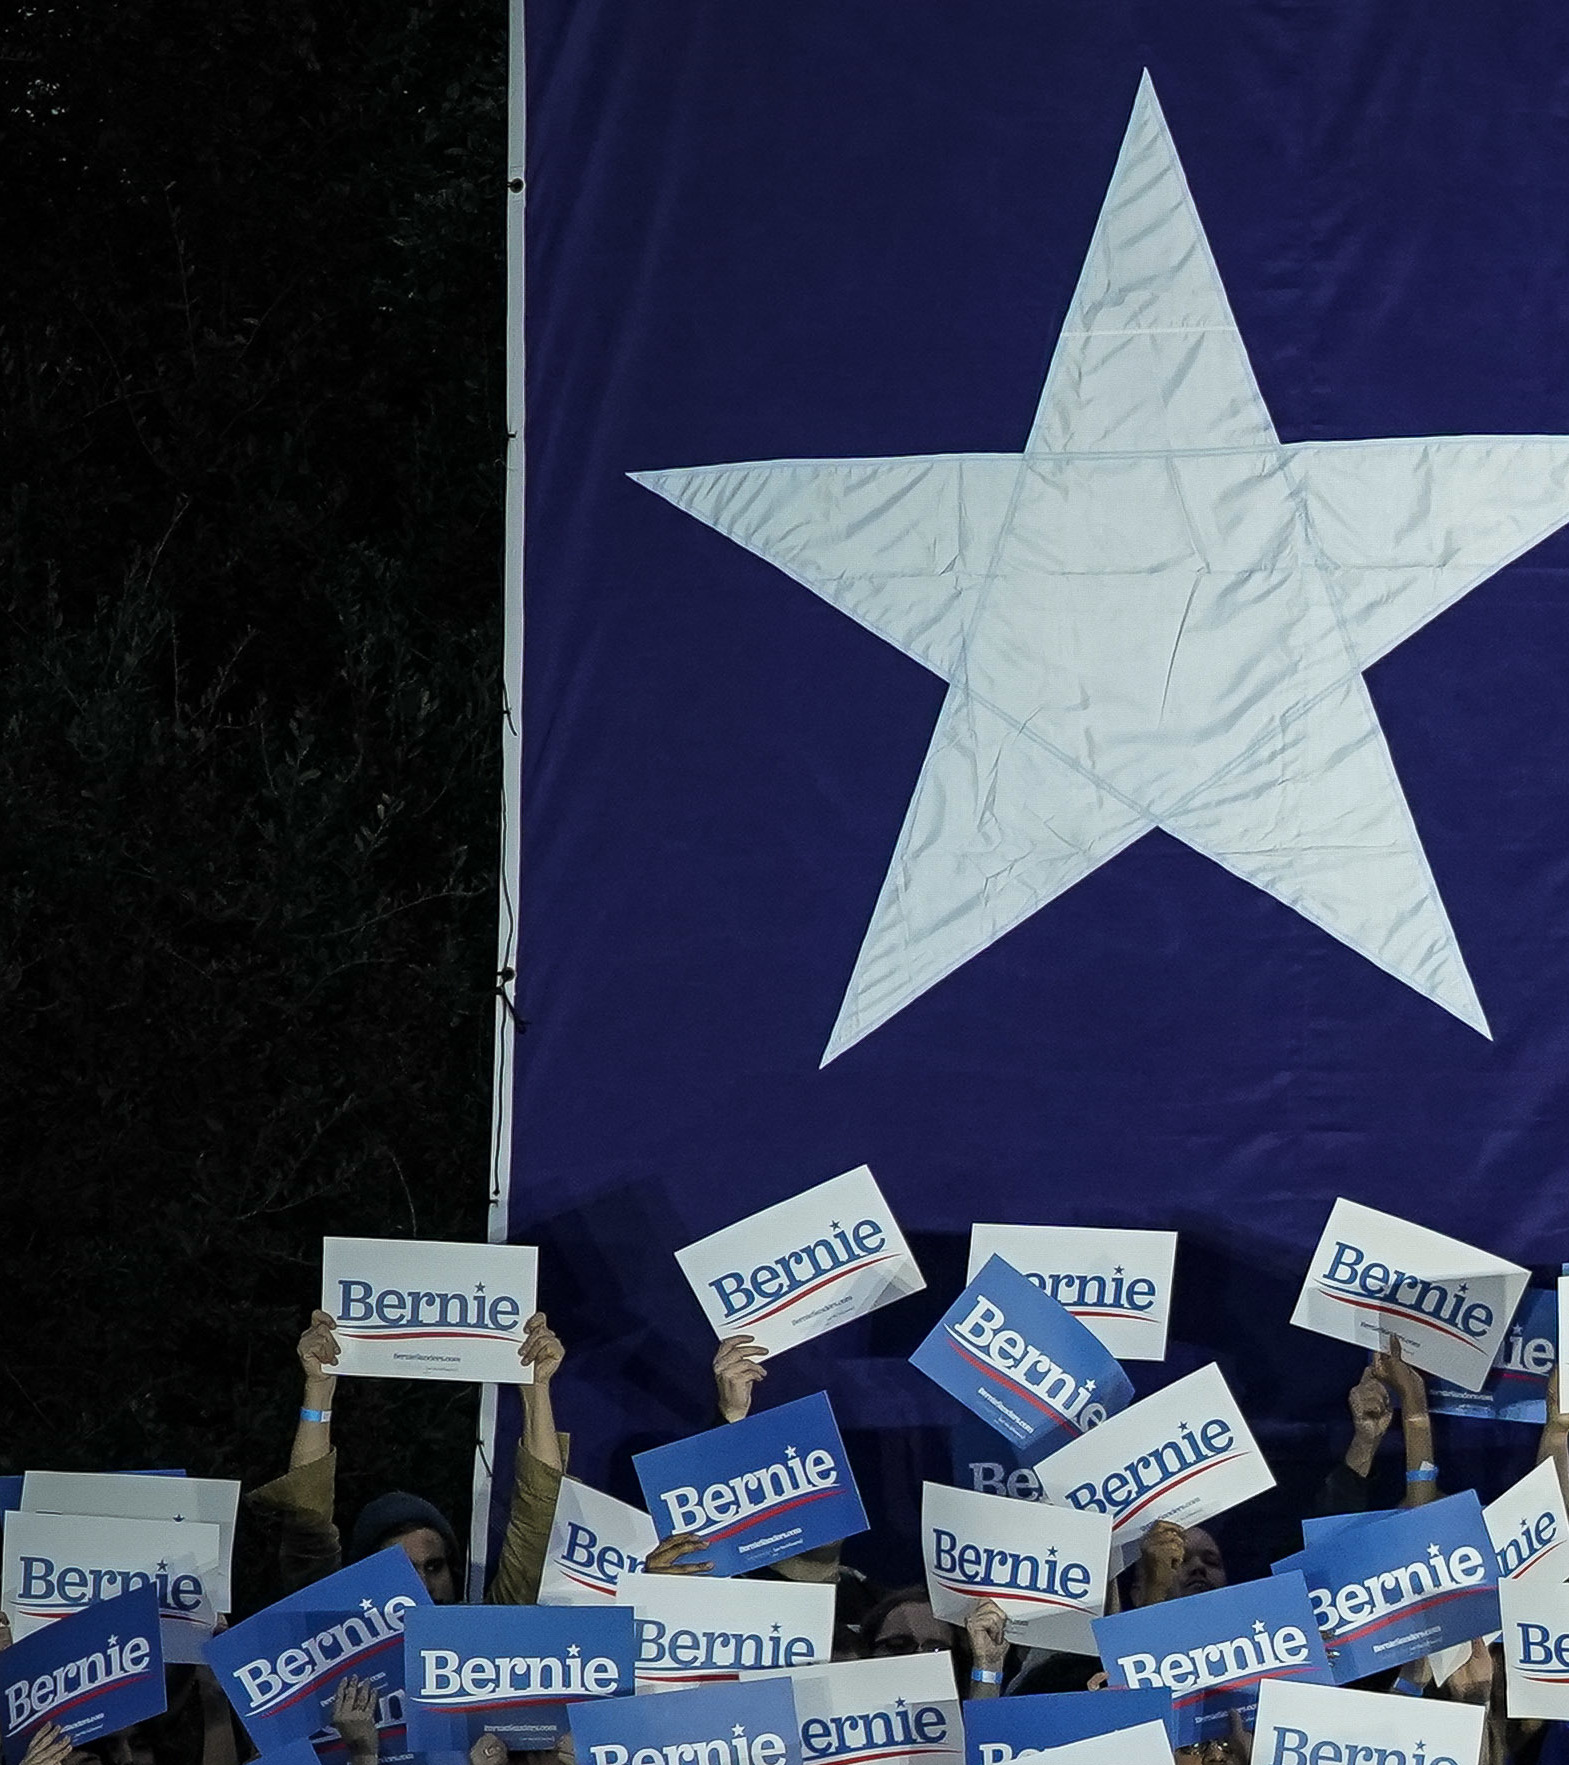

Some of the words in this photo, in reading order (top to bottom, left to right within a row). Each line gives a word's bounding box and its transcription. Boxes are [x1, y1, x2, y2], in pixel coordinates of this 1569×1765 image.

[709, 1219, 886, 1320] Bernie
[1322, 1242, 1494, 1339] Bernie
[338, 1281, 520, 1331] Bernie
[954, 1295, 1108, 1430] Bernie
[662, 1446, 839, 1536] Bernie
[932, 1528, 1091, 1598] Bernie
[1494, 1507, 1558, 1579] nie
[4, 1634, 150, 1724] Bernie
[420, 1644, 619, 1695] Bernie
[637, 1623, 816, 1670] Bernie
[801, 1698, 947, 1753] ernie
